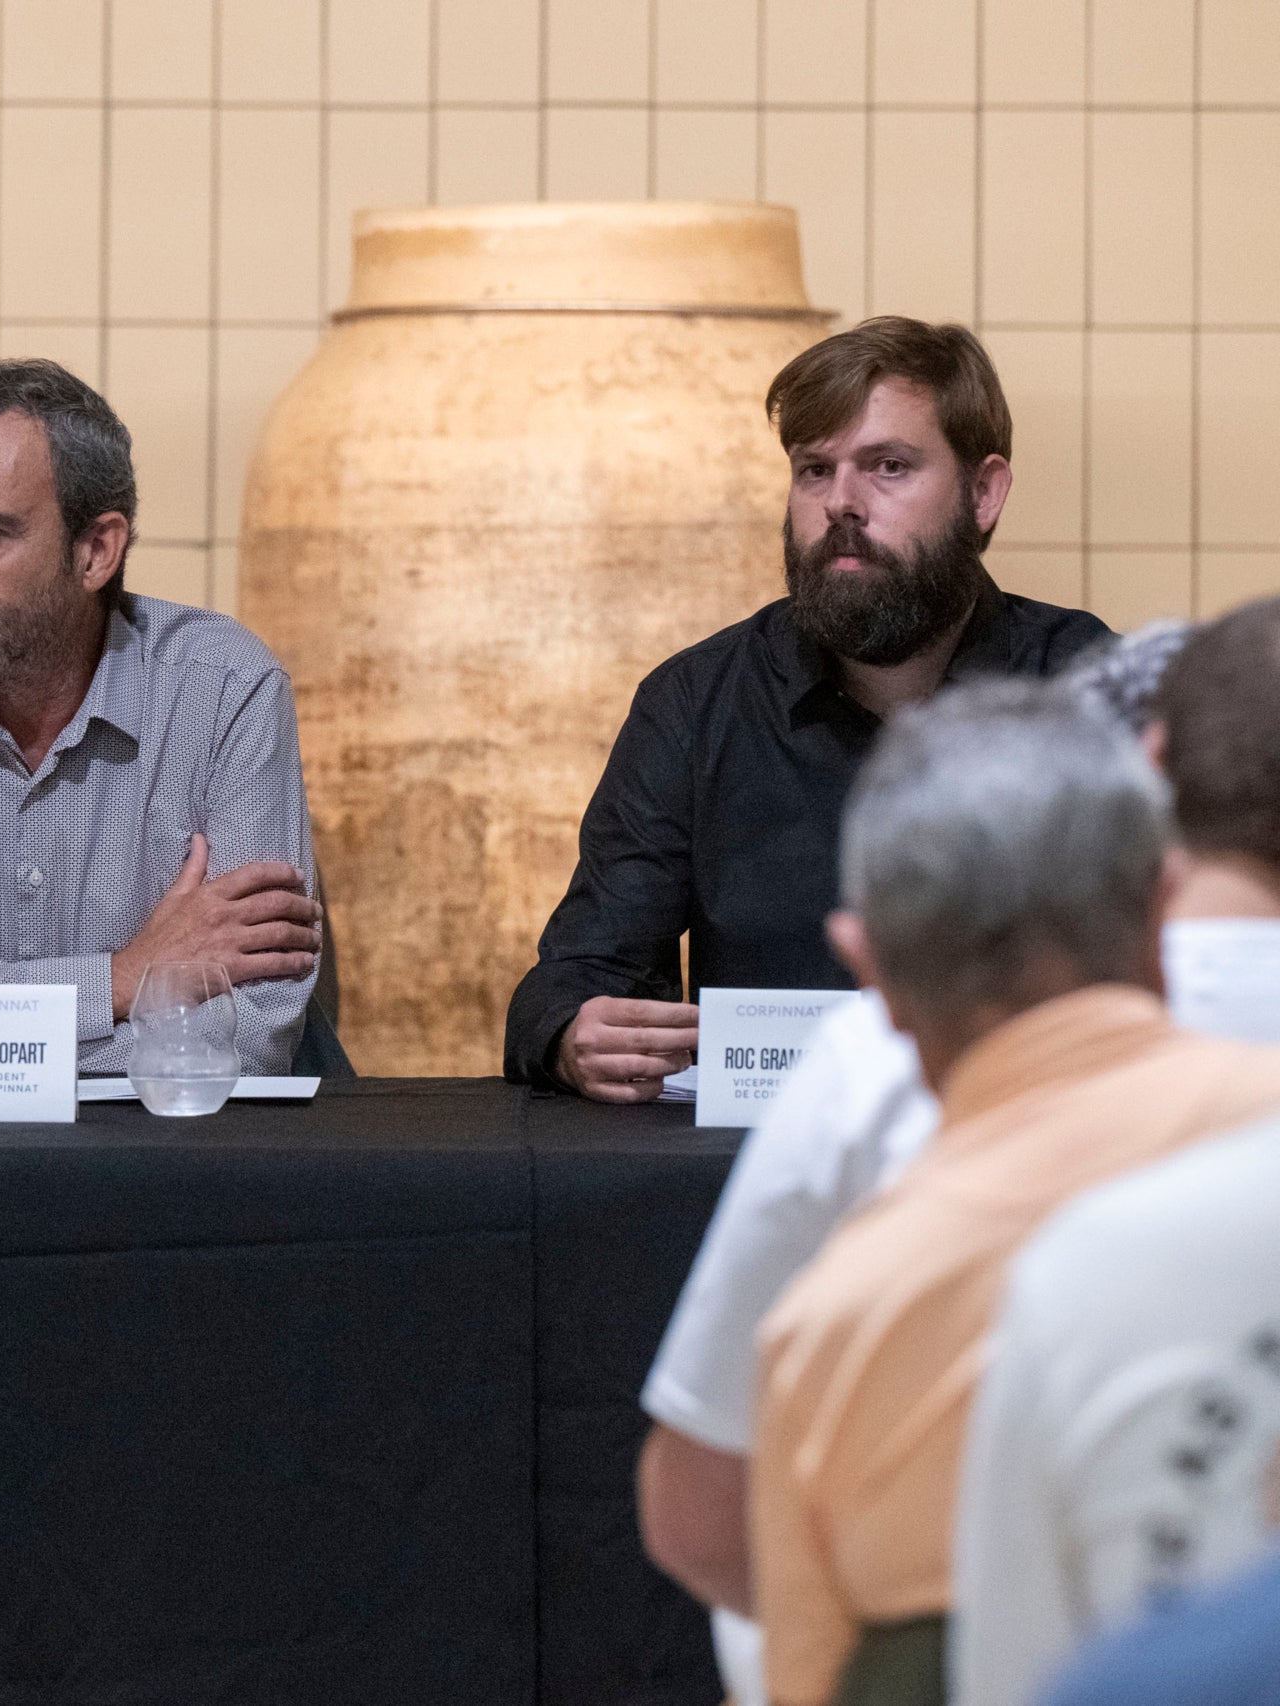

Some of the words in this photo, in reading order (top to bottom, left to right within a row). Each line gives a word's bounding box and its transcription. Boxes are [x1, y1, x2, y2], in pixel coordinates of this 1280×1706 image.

[735, 1004, 824, 1018] CORPINNAT
[724, 1046, 756, 1070] ROC
[734, 1089, 749, 1099] DE
